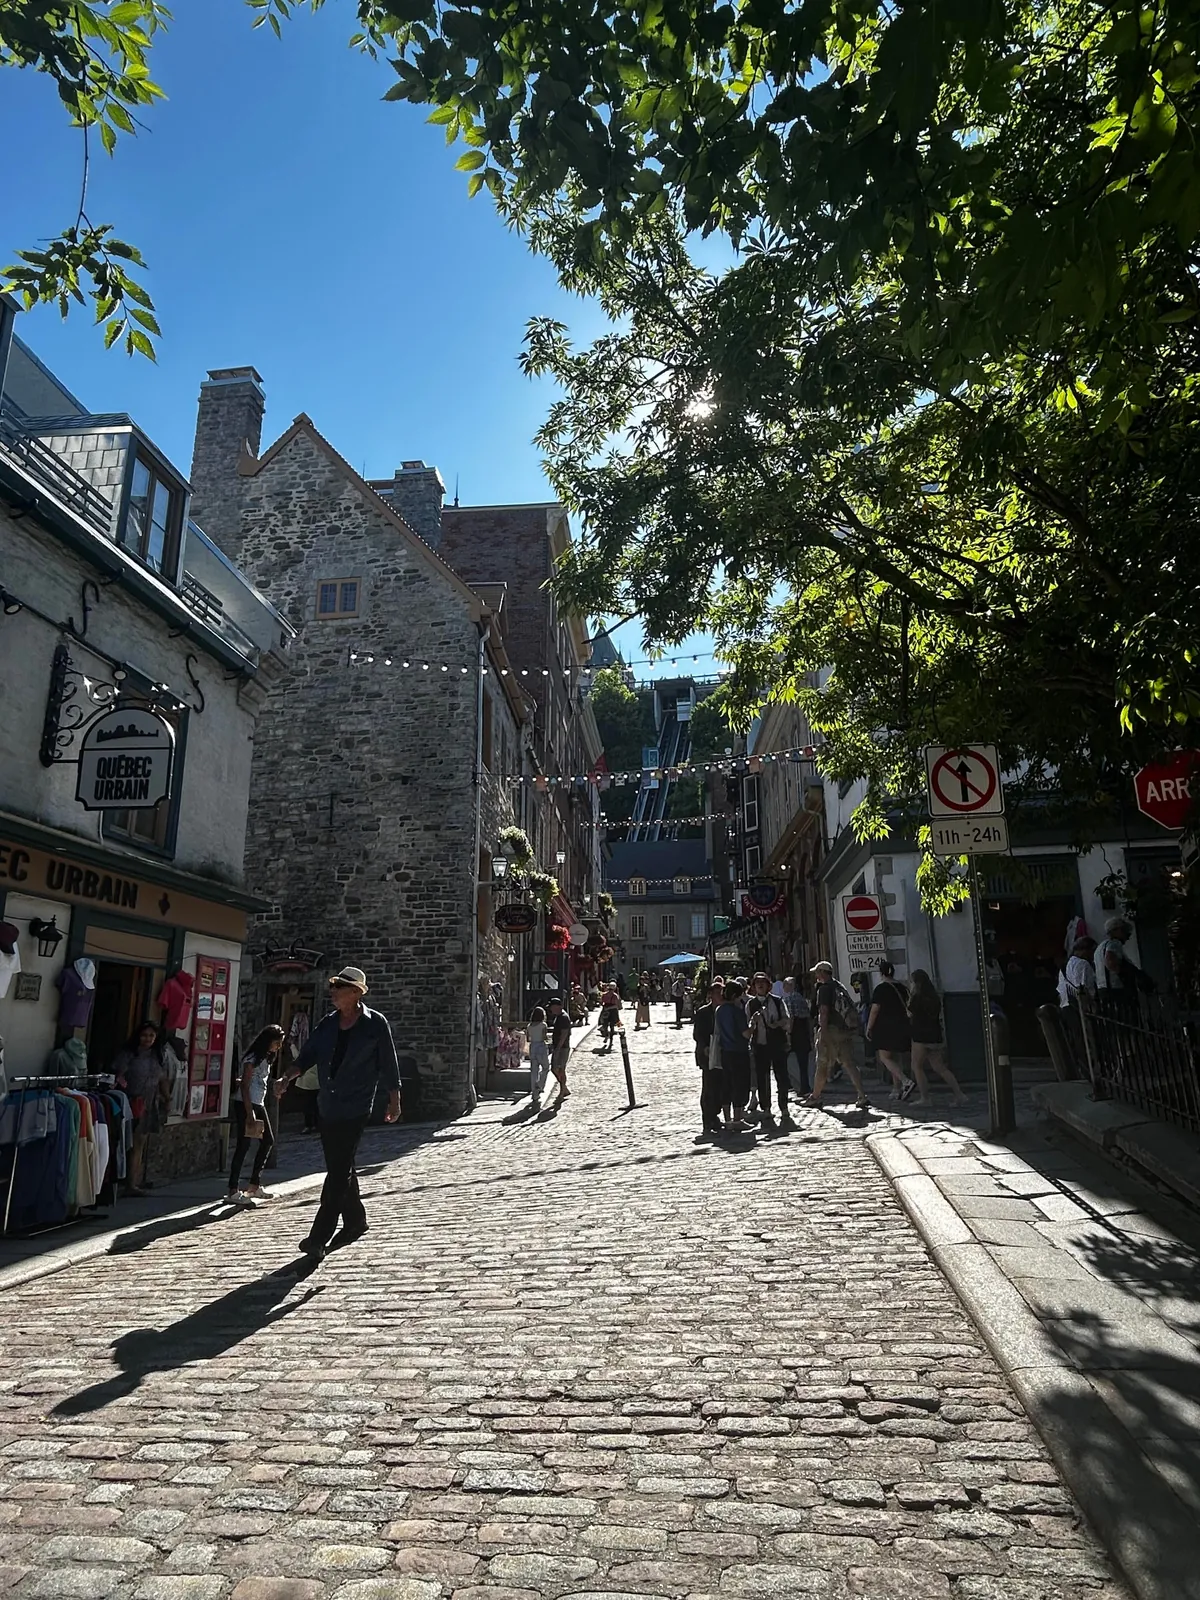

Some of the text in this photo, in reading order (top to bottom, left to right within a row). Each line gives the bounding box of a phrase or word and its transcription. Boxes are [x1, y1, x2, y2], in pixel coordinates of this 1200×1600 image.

[97, 754, 152, 779] QUÉBEC
[94, 779, 150, 801] URBAIN
[46, 859, 138, 909] URBAIN
[853, 935, 879, 943] ENTRÉE
